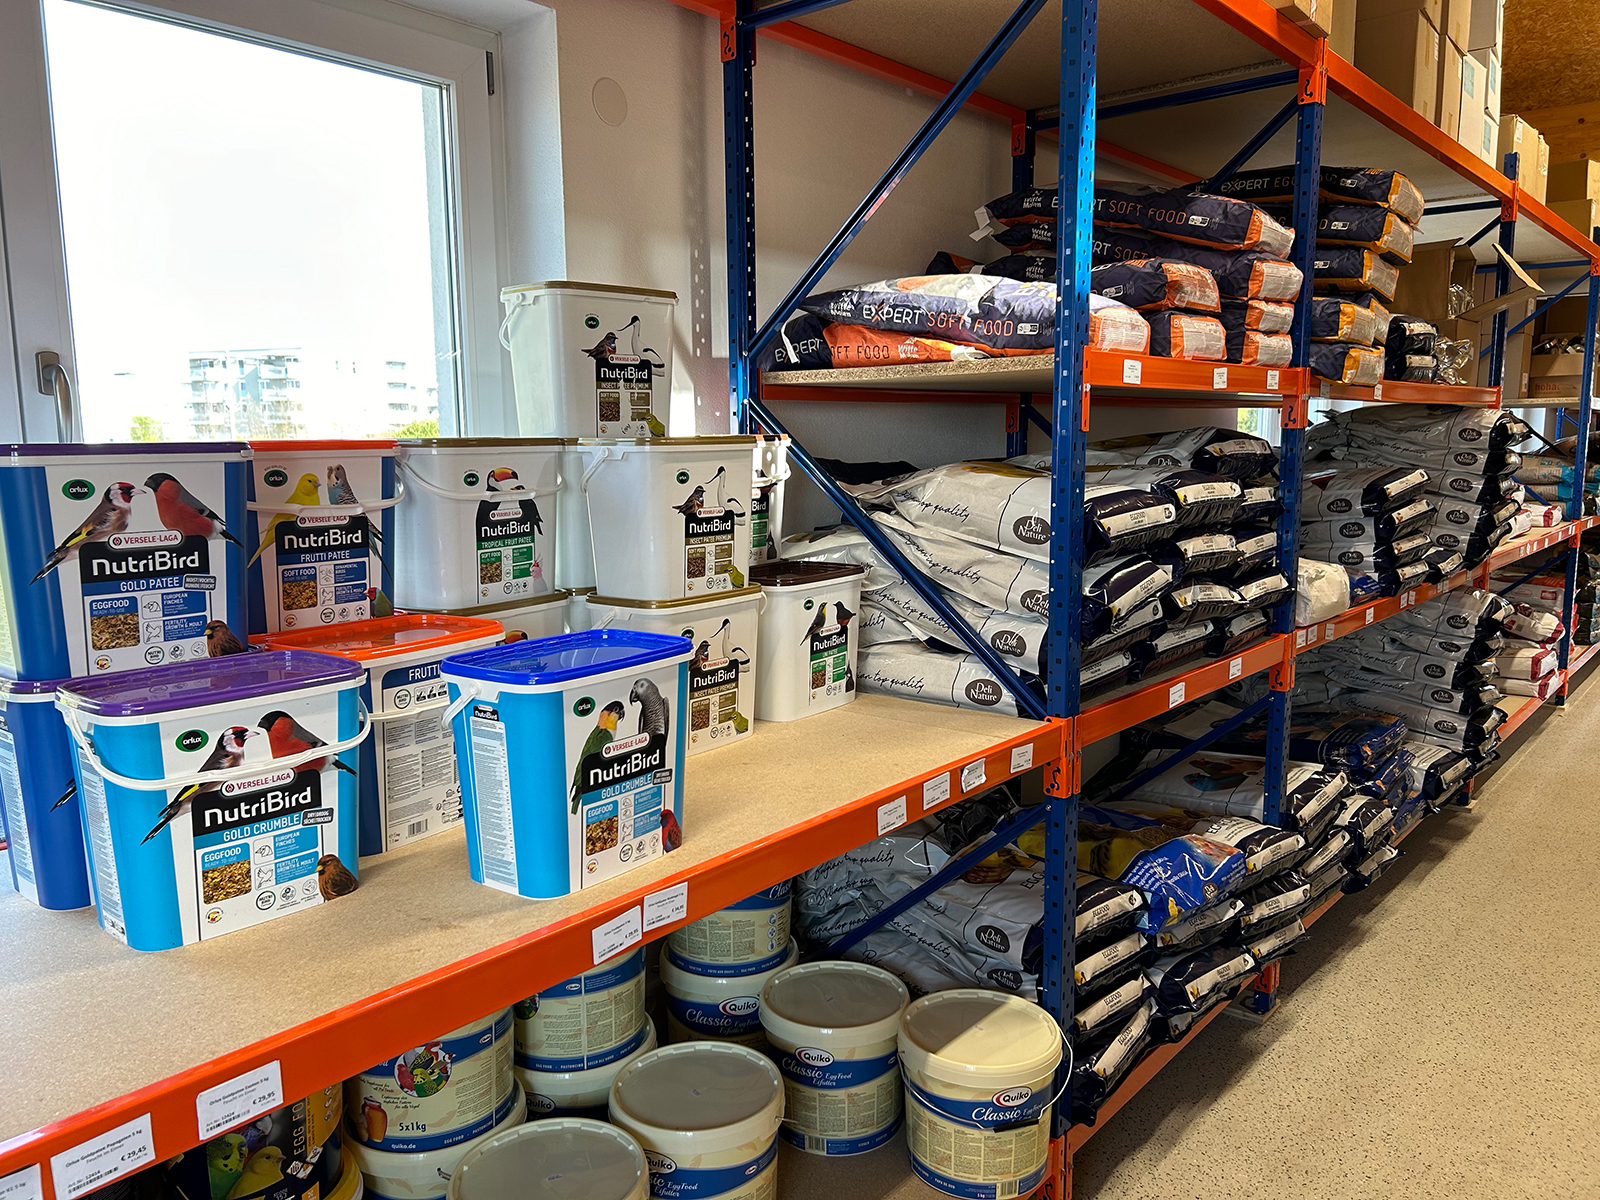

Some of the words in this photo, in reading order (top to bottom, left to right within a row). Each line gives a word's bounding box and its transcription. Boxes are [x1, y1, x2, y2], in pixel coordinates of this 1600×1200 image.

[1221, 178, 1270, 193] EXPERT
[1109, 200, 1143, 216] SOFT
[1148, 208, 1186, 224] FOOD
[1032, 228, 1051, 237] Witte
[1114, 246, 1148, 260] SOFT
[863, 303, 923, 325] EXPERT
[927, 311, 966, 330] SOFT
[973, 318, 1013, 337] FOOD
[857, 346, 890, 359] FOOD
[934, 502, 970, 522] quality
[1026, 519, 1042, 532] Deli
[124, 534, 178, 544] VERSELE-LAGA
[1017, 526, 1047, 541] Nature
[482, 540, 504, 548] TROPICAL
[301, 553, 326, 562] FRUTTI
[328, 551, 350, 560] PATEE
[940, 563, 981, 584] quality
[120, 580, 147, 592] GOLD
[150, 577, 179, 588] PATEE
[93, 599, 129, 610] EGGFOOD
[902, 600, 917, 614] top
[1001, 632, 1017, 646] Deli
[1344, 670, 1370, 682] Belgian
[694, 690, 707, 698] INSECT
[708, 688, 719, 696] PATEE
[720, 683, 736, 692] PREMIUM
[872, 676, 889, 688] top
[890, 677, 924, 694] quality
[976, 682, 992, 695] Deli
[970, 690, 999, 702] Nature
[183, 735, 202, 745] orlux
[612, 736, 647, 752] VERSELE-LAGA
[236, 772, 291, 790] VERSELE-LAGA
[602, 785, 620, 799] GOLD
[622, 774, 651, 792] CRUMBLE
[588, 804, 613, 817] EGGFOOD
[224, 826, 251, 842] GOLD
[254, 814, 300, 834] CRUMBLE
[276, 832, 300, 842] EUROPEAN
[276, 838, 295, 847] FINCHES
[204, 847, 241, 862] EGGFOOD
[859, 850, 895, 866] quality
[979, 932, 1006, 951] Nature
[986, 927, 1003, 942] Deli
[918, 935, 951, 959] quality
[729, 1000, 757, 1012] Quiko
[686, 1008, 733, 1027] Classic
[804, 1052, 830, 1063] Quiko
[782, 1058, 823, 1078] Classic
[258, 1091, 275, 1103] 29,95
[526, 1097, 552, 1110] Quiko
[1003, 1091, 1029, 1102] Quiko
[972, 1107, 1022, 1121] Classic
[293, 1126, 305, 1155] EGG
[127, 1145, 146, 1159] 29,45
[66, 1159, 80, 1168] Orlux
[654, 1186, 680, 1197] Eifutter
